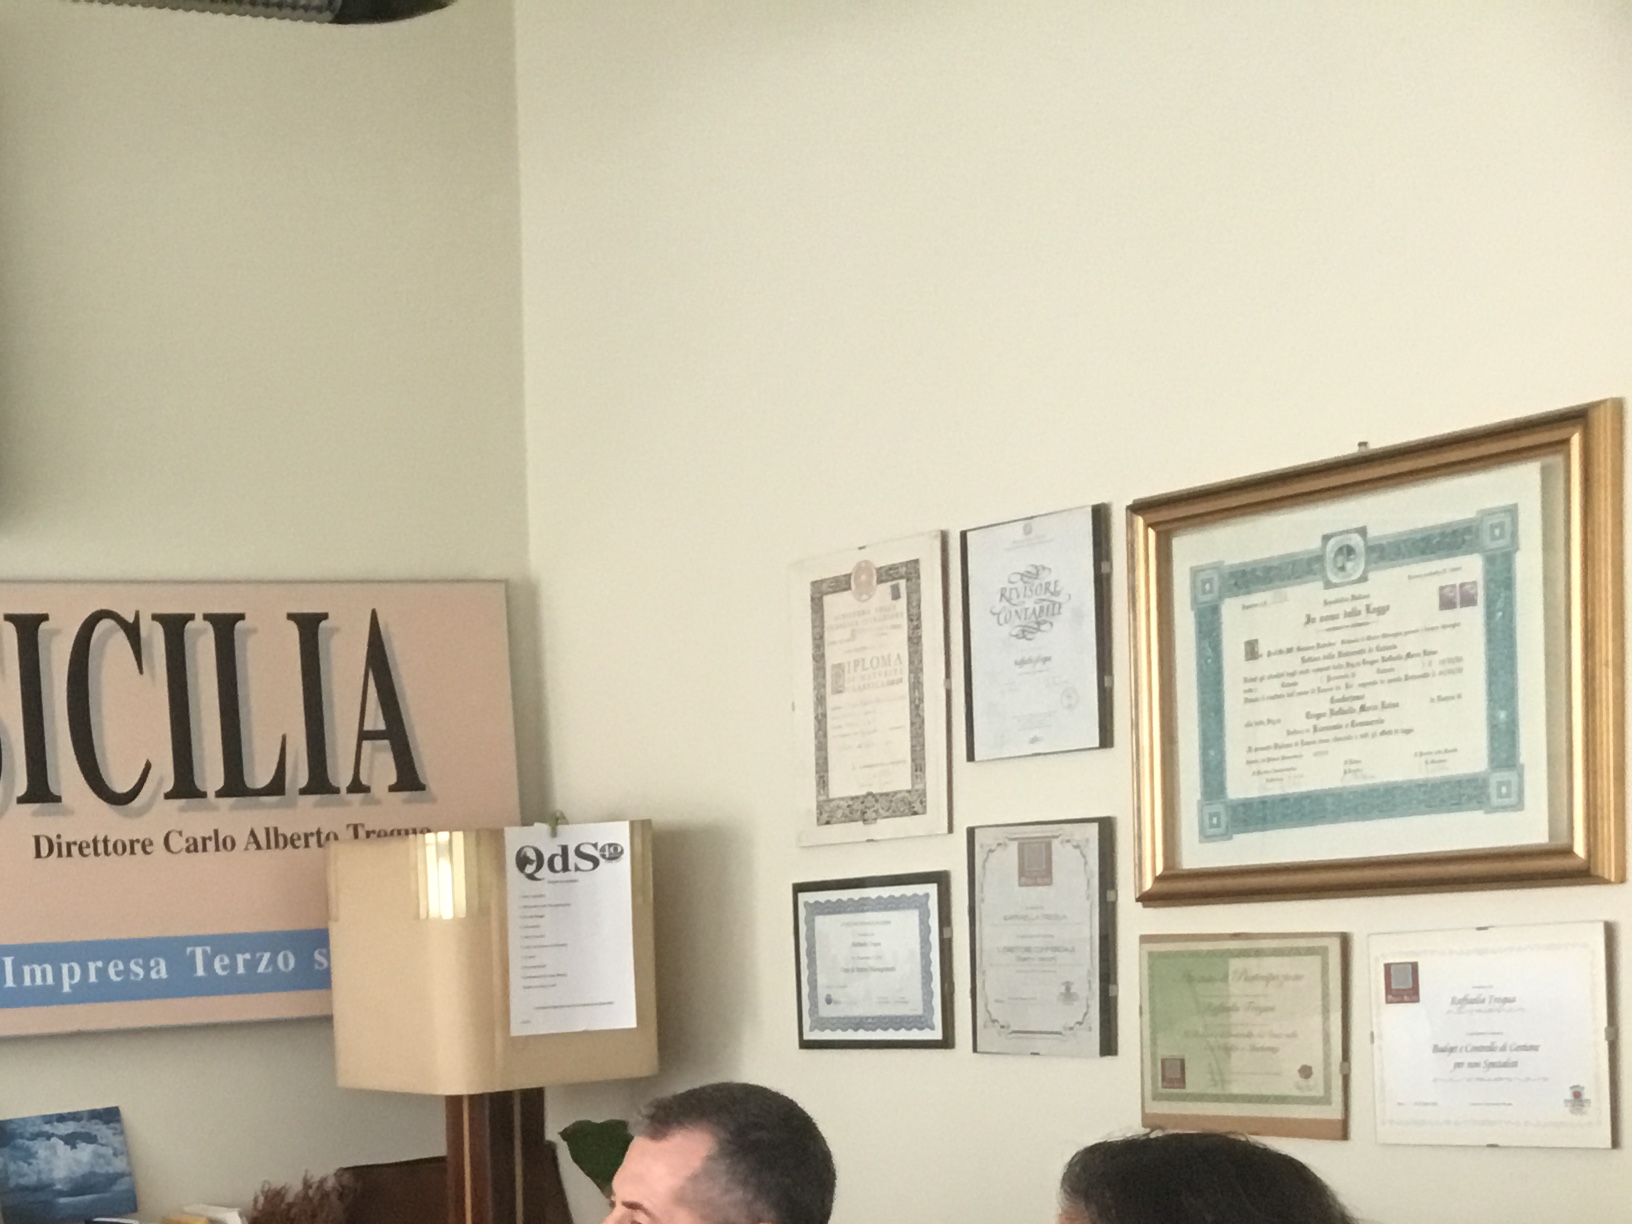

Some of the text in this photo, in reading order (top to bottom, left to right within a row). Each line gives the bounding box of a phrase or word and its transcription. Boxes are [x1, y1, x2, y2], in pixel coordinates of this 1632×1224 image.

[32, 832, 154, 860] Direttore
[162, 826, 237, 856] Carlo
[243, 826, 340, 852] Alberto
[515, 841, 601, 882] QdS
[1, 953, 169, 993] Impresa
[186, 945, 296, 979] Terzo
